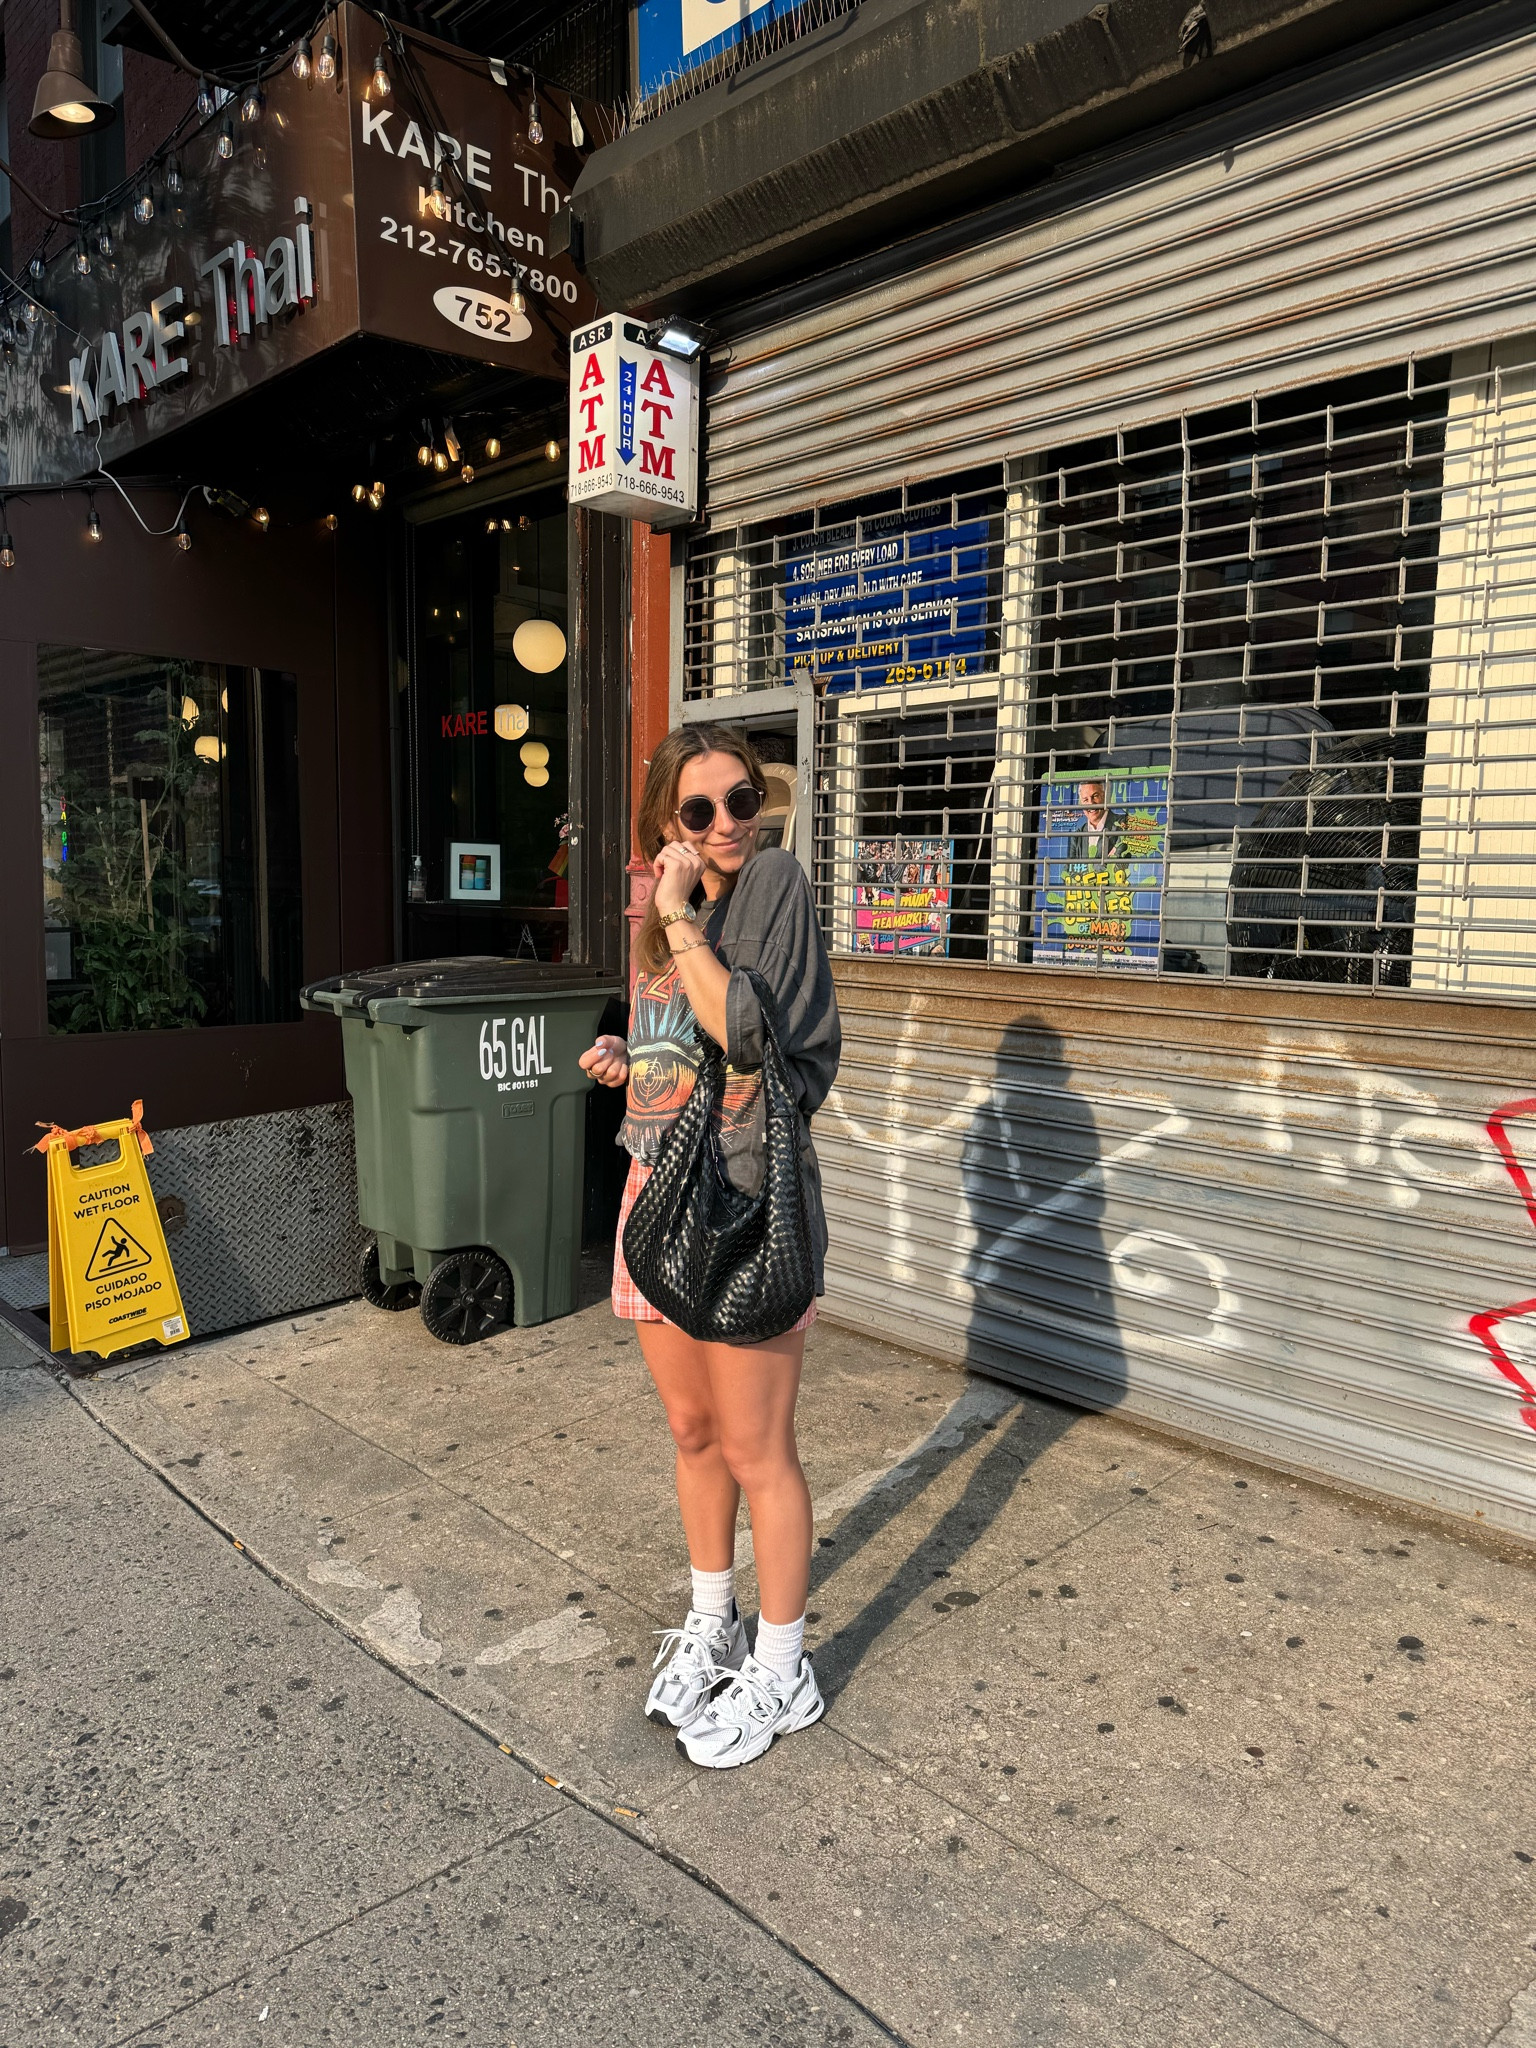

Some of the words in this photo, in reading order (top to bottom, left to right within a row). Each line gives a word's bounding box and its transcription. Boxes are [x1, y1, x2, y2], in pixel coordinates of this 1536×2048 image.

[362, 101, 492, 192] KARE
[418, 186, 544, 256] Kitchen
[69, 286, 188, 434] KARE
[200, 196, 313, 348] Thai
[455, 295, 511, 337] 752
[579, 327, 605, 349] ASR
[623, 371, 633, 395] 24
[579, 353, 605, 474] ATM
[623, 401, 633, 450] HOUR
[640, 359, 675, 481] ATM
[571, 473, 613, 498] 718-666-9543
[617, 474, 685, 504] 718-666-9543
[834, 553, 850, 572] FOR
[851, 547, 876, 568] EVERY
[876, 542, 898, 562] LOAD
[879, 575, 899, 592] WITH
[873, 611, 882, 628] IS
[820, 651, 834, 665] UP
[847, 642, 900, 660] DELIVERY
[441, 711, 487, 738] KARE
[495, 705, 529, 732] Thai
[1115, 870, 1130, 896] &
[872, 916, 892, 929] FLEA
[1078, 923, 1089, 933] OF
[480, 1018, 507, 1080] 65
[511, 1015, 552, 1076] GAL
[497, 1082, 511, 1092] BIC
[512, 1079, 538, 1090] #01181
[79, 1183, 131, 1204] CAUTION
[74, 1204, 101, 1220] WET
[102, 1194, 140, 1213] FLOOR
[85, 1297, 111, 1312] PISO
[113, 1281, 162, 1304] MOJADO
[95, 1272, 148, 1295] CUIDADO
[108, 1307, 148, 1324] COASTWIDE
